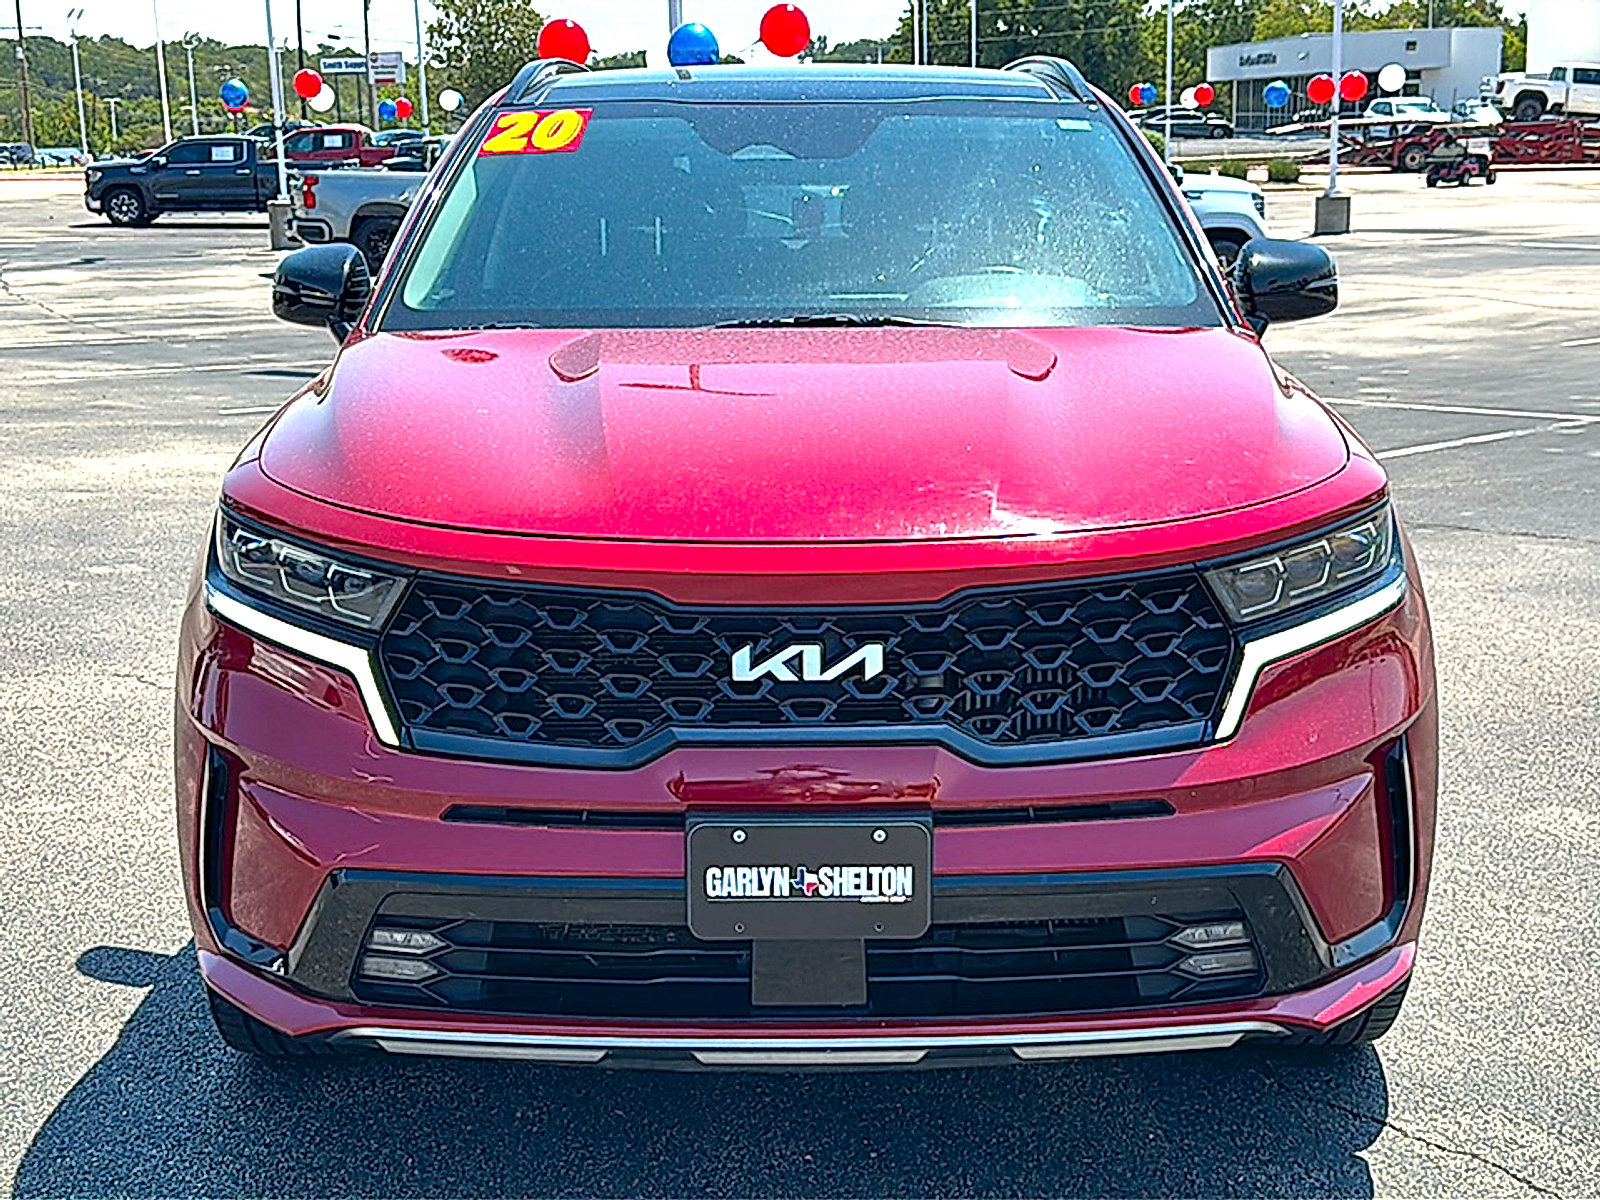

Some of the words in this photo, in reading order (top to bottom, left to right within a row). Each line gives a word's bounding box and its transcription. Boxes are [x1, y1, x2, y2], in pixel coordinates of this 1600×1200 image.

[482, 109, 582, 152] 20
[732, 643, 884, 682] KIA
[706, 866, 790, 897] GARLYN
[818, 866, 914, 897] SHELTON
